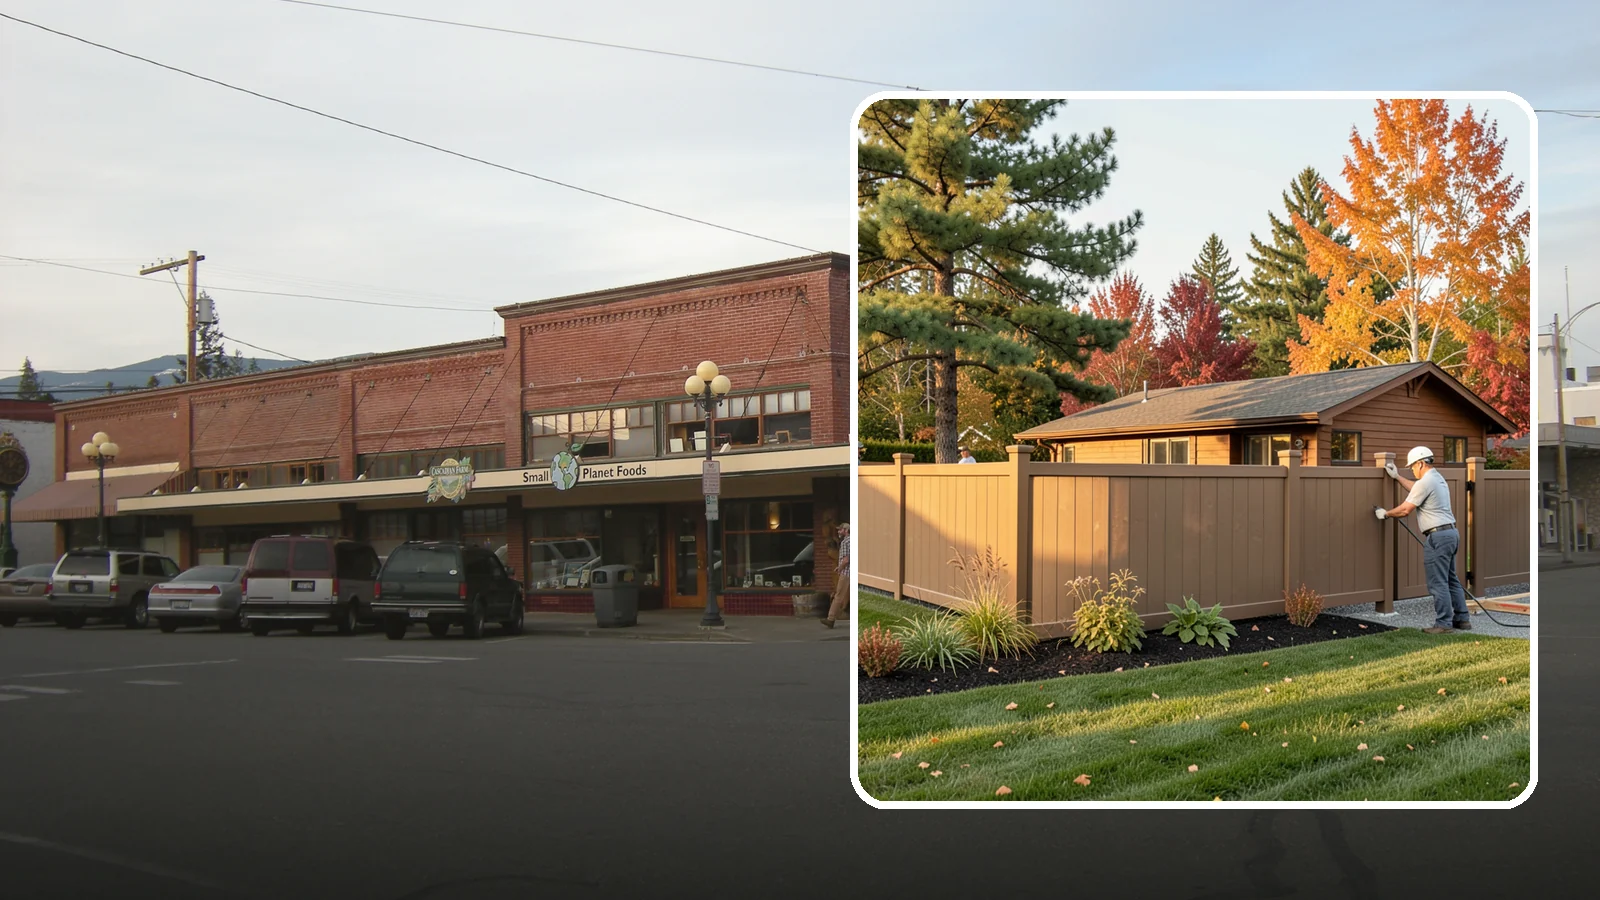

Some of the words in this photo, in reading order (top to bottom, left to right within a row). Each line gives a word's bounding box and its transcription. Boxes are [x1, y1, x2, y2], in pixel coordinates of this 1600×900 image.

[523, 471, 548, 482] Small
[583, 468, 614, 479] Planet
[617, 465, 647, 477] Foods
